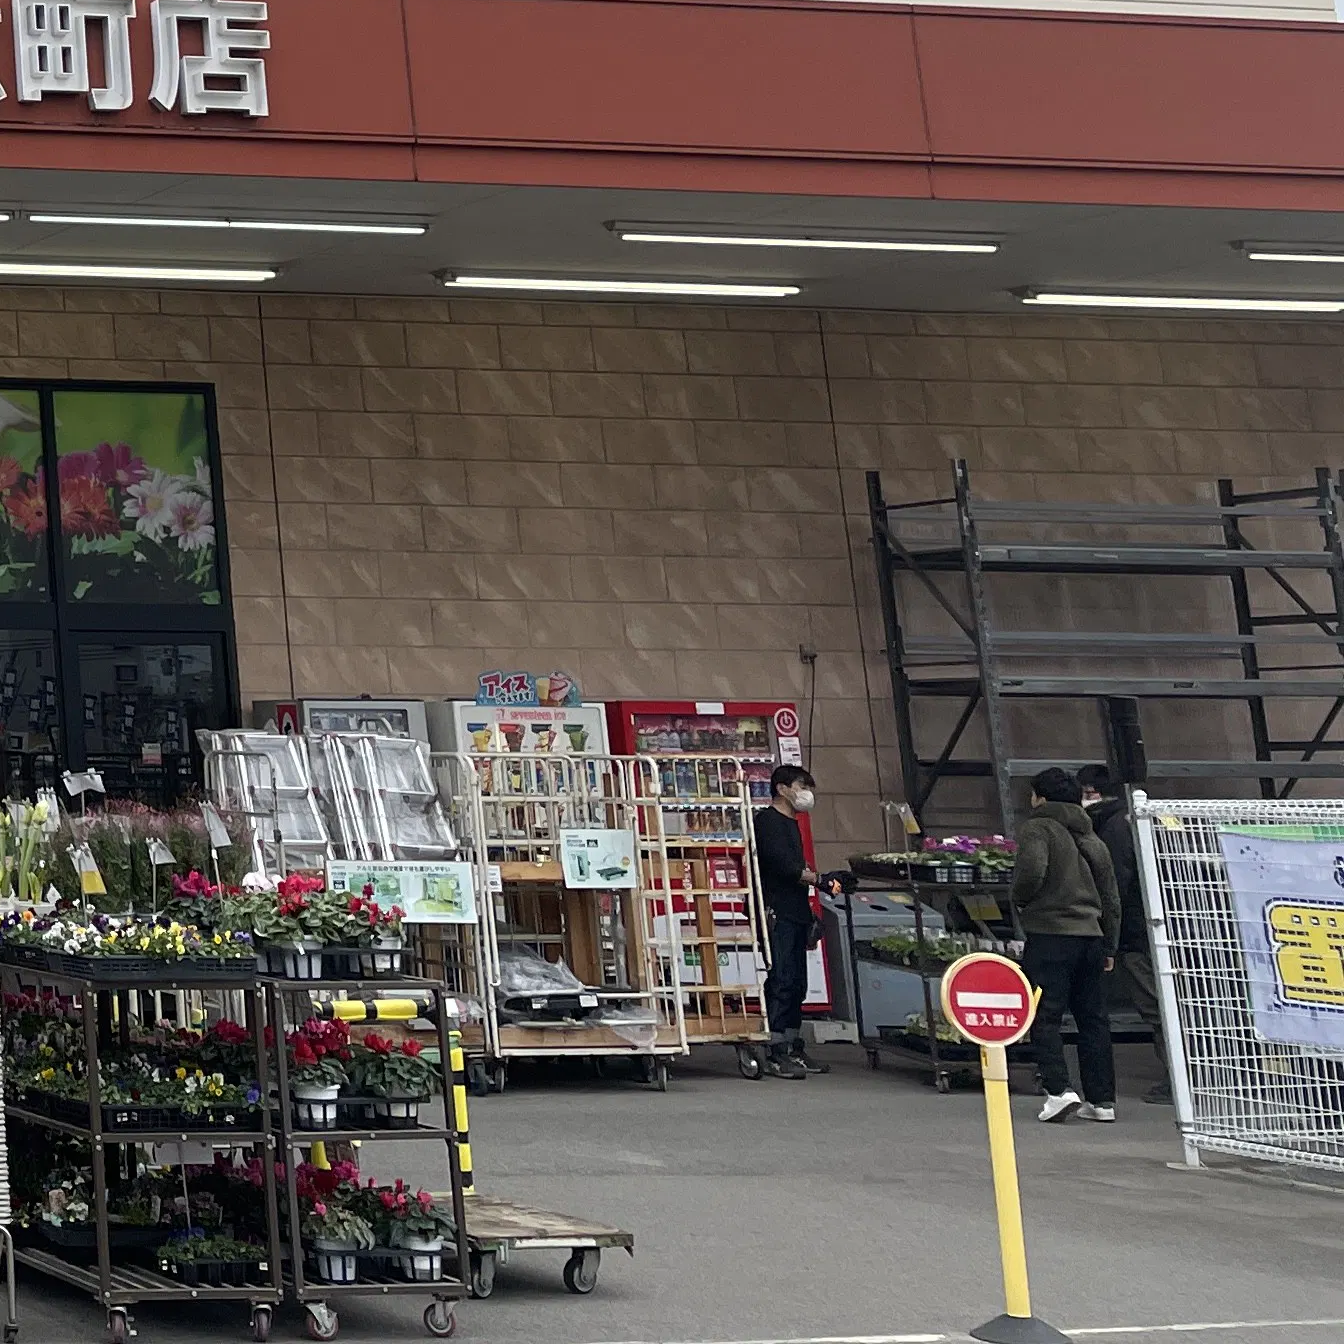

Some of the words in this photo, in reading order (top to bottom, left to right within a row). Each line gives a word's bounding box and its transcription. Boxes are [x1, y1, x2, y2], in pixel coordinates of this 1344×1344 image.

[481, 673, 529, 697] アイス
[964, 1012, 1019, 1028] 進入禁止
